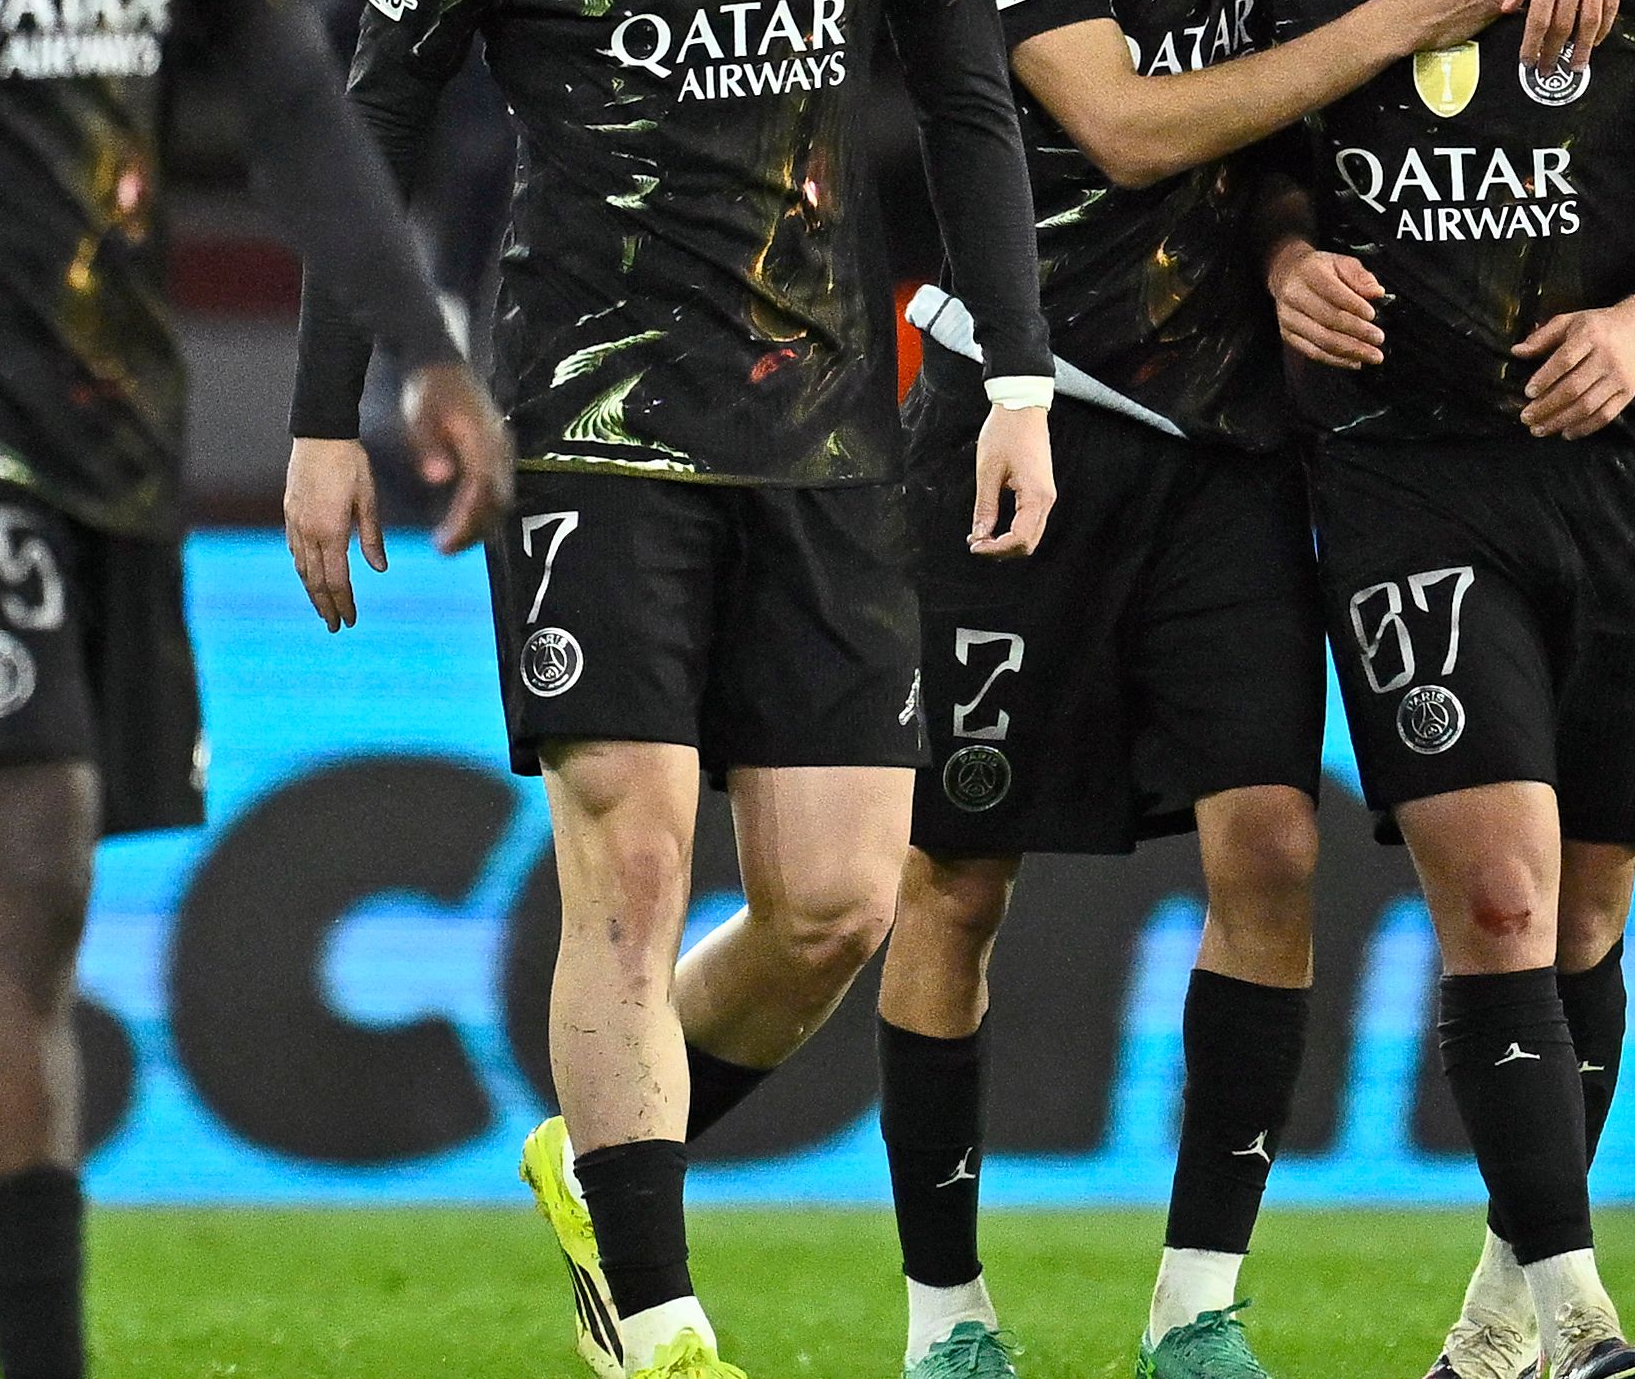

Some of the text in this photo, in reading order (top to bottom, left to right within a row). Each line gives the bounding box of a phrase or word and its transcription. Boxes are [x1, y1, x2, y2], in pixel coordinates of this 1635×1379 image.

[677, 51, 847, 103] AIRWAYS
[1335, 147, 1578, 214] QATAR
[1396, 200, 1581, 242] AIRWAYS
[521, 510, 579, 625] 7
[531, 633, 569, 652] PARIS
[1349, 565, 1475, 695] 87
[953, 627, 1025, 741] 2
[1405, 691, 1446, 712] PARIS
